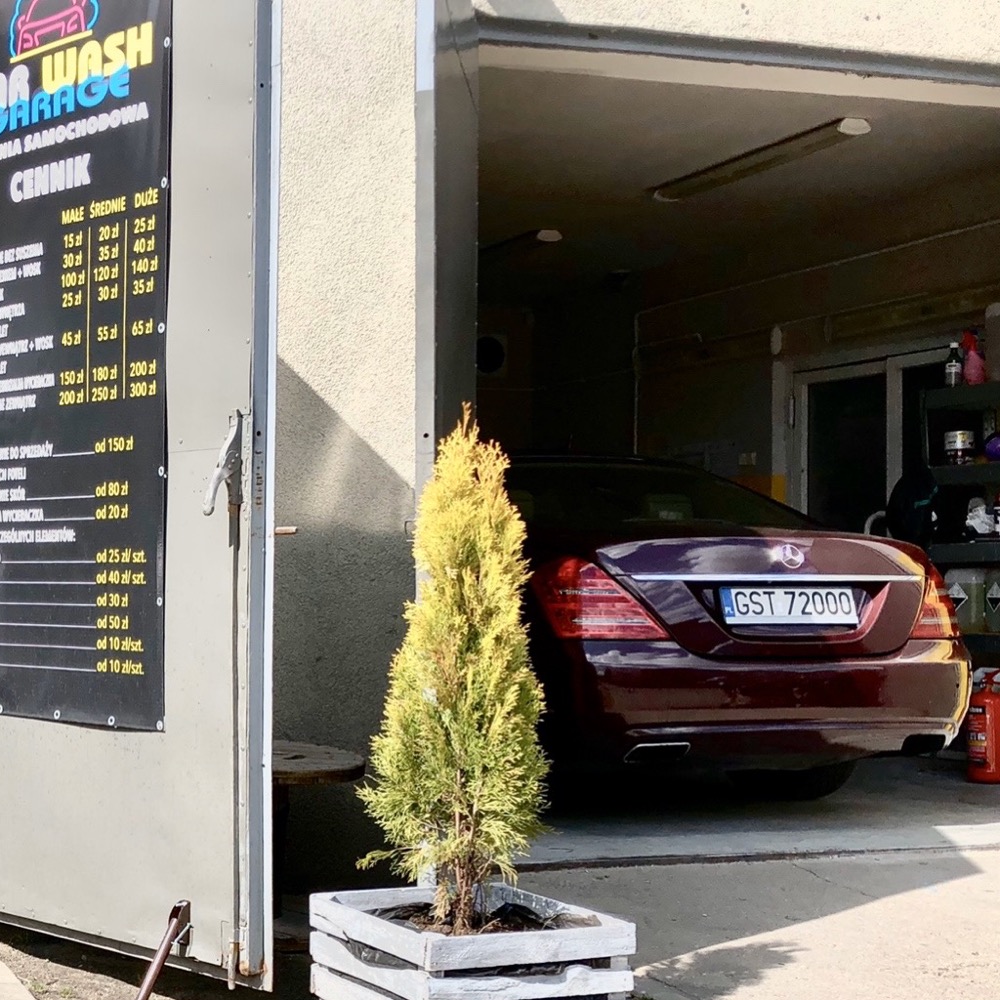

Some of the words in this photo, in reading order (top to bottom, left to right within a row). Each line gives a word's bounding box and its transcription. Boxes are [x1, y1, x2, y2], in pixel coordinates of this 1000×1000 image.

[42, 21, 153, 94] WASH
[24, 102, 149, 153] SAMOCHODOWA
[10, 153, 91, 203] CENNIK
[61, 205, 85, 225] MAŁE
[89, 195, 127, 219] ŚREDNIE
[134, 187, 159, 209] DUŻE
[99, 225, 110, 241] 20
[111, 224, 119, 238] zł
[134, 217, 146, 233] 25
[147, 215, 155, 231] zł
[64, 233, 74, 248] 15
[75, 232, 82, 246] zł
[133, 238, 146, 253] 40
[147, 236, 155, 251] zł
[63, 253, 74, 268] 30
[75, 251, 82, 266] zł
[99, 245, 110, 261] 35
[111, 244, 119, 258] zł
[94, 266, 110, 281] 120
[111, 264, 118, 279] zł
[132, 258, 149, 273] 140
[150, 256, 158, 271] zł
[61, 272, 77, 288] 100
[78, 270, 85, 285] zł
[133, 279, 145, 295] 35
[146, 278, 154, 292] zł
[62, 292, 73, 307] 25
[75, 291, 82, 305] zł
[98, 286, 109, 301] 30
[111, 283, 118, 299] zł
[98, 326, 108, 341] 55
[110, 325, 117, 339] zł
[132, 320, 144, 336] 65
[145, 319, 153, 334] zł
[62, 332, 72, 346] 45
[74, 331, 81, 345] zł
[92, 366, 109, 381] 180
[110, 365, 117, 379] zł
[130, 361, 147, 377] 200
[148, 360, 156, 374] zł
[60, 371, 75, 385] 150
[77, 370, 84, 383] zł
[59, 390, 75, 405] 200
[76, 389, 84, 403] zł
[92, 386, 108, 401] 250
[110, 386, 117, 399] zł
[130, 382, 147, 397] 300
[148, 380, 156, 395] zł
[95, 439, 106, 453] od
[108, 437, 124, 452] 150
[126, 436, 133, 450] zł
[96, 482, 106, 497] od
[108, 482, 120, 496] 80
[121, 482, 128, 495] zł
[96, 505, 106, 519] od
[108, 505, 119, 519] 20
[121, 504, 128, 518] zł
[96, 549, 107, 563] od
[109, 549, 120, 563] 25
[96, 571, 107, 584] od
[108, 570, 120, 584] 40
[97, 593, 107, 607] od
[109, 593, 120, 607] 30
[121, 594, 128, 607] zł
[734, 591, 775, 615] GST
[784, 591, 851, 615] 72000
[96, 615, 107, 628] od
[109, 616, 120, 629] 50
[121, 616, 128, 629] zł
[97, 636, 107, 649] od
[109, 637, 120, 650] 10
[97, 659, 107, 672] od
[109, 659, 120, 673] 10
